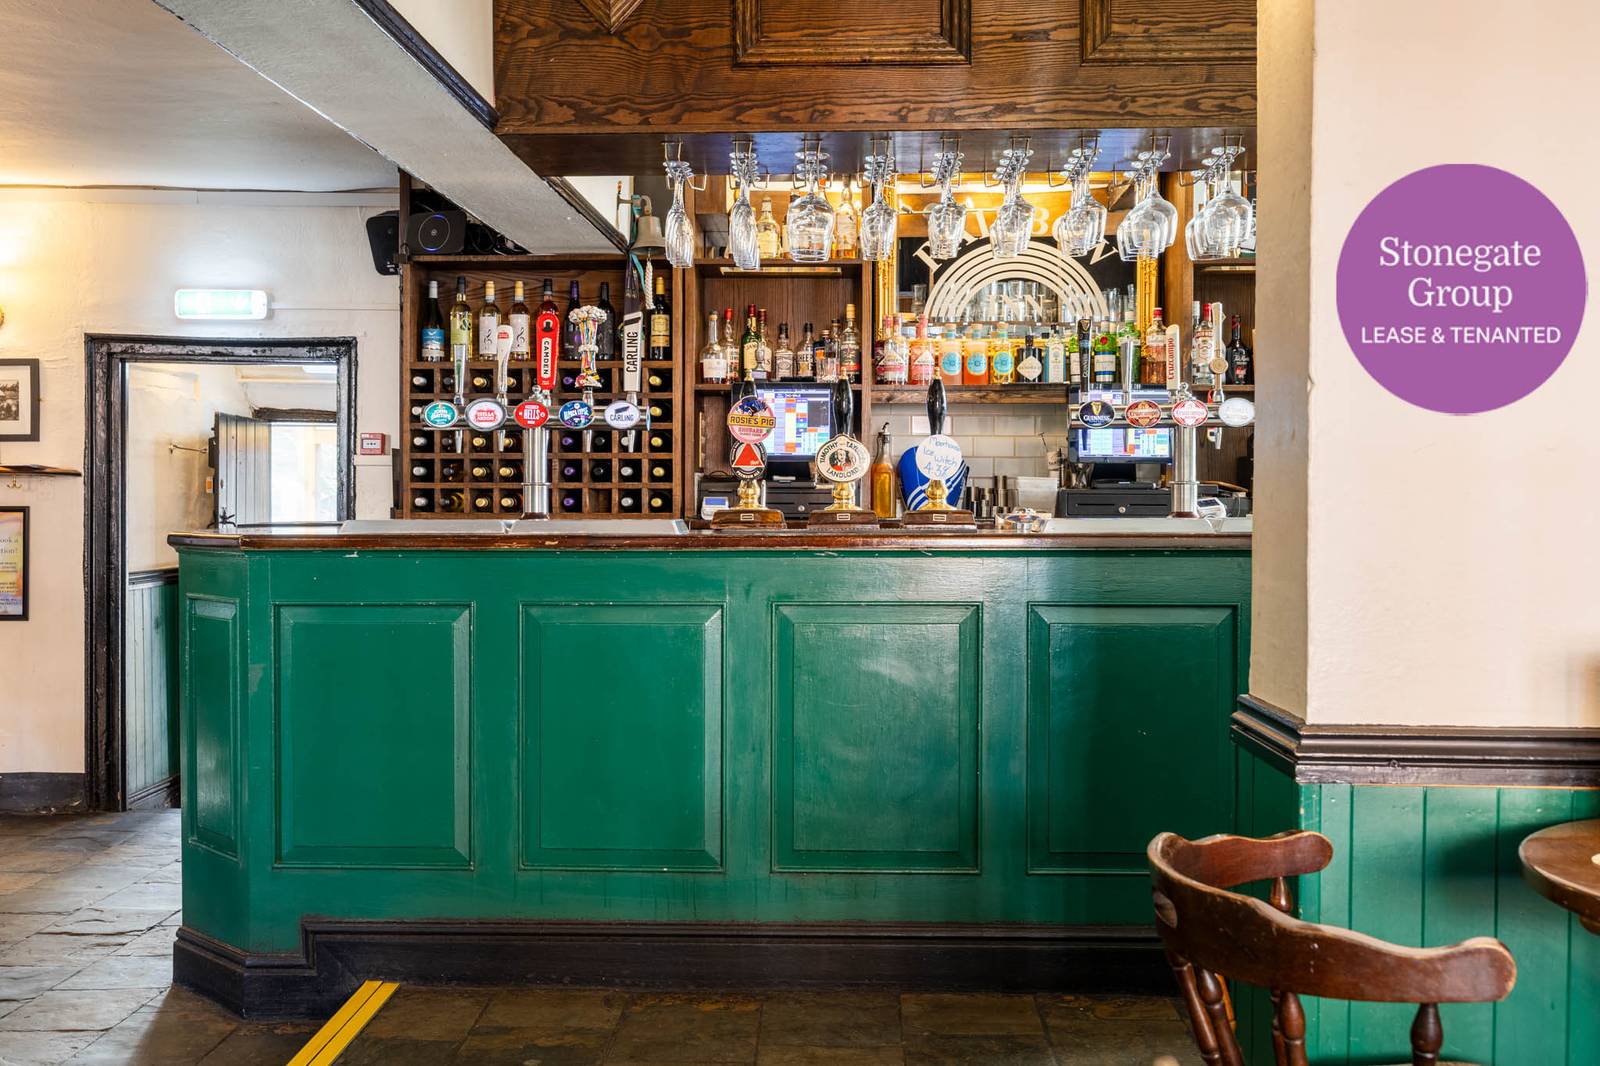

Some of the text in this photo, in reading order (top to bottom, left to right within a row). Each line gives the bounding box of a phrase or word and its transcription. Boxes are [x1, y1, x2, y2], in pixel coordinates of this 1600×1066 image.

[988, 294, 1044, 317] INN
[626, 331, 638, 373] CARLING
[524, 409, 540, 420] HELLS
[730, 416, 774, 426] ROSIE'S PIG
[1083, 414, 1111, 422] GUINNESS
[820, 441, 838, 463] TIMOTHY
[826, 466, 859, 479] LANDLORD
